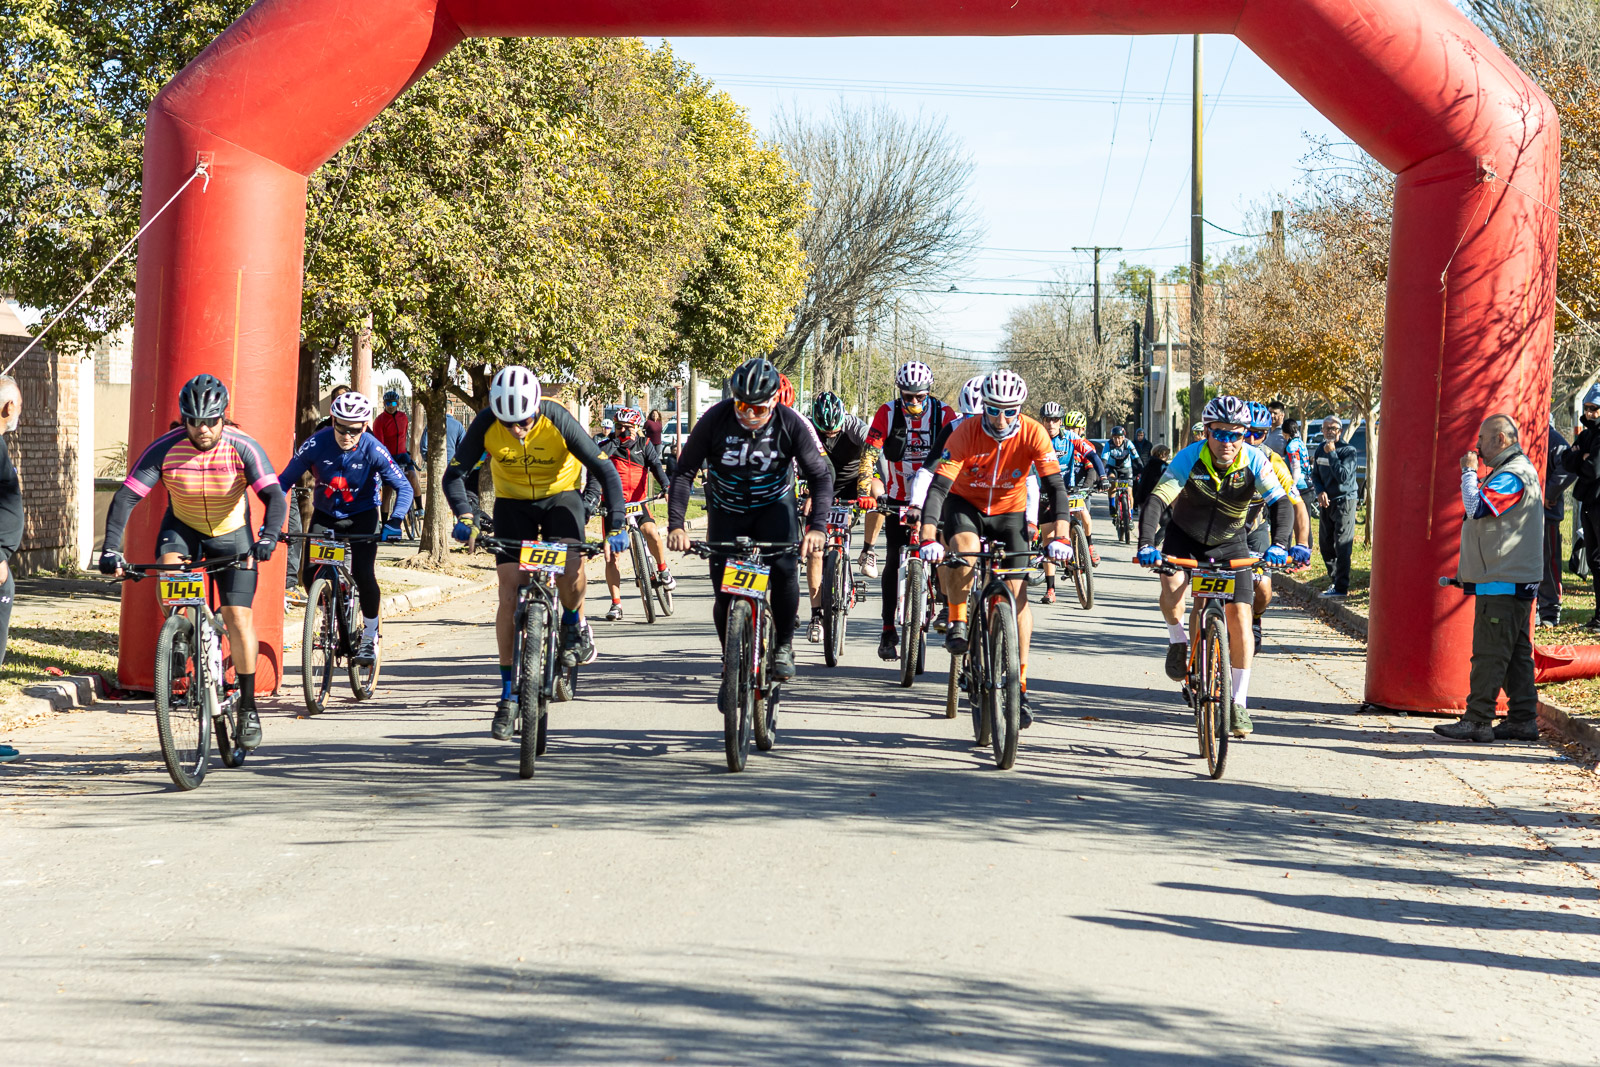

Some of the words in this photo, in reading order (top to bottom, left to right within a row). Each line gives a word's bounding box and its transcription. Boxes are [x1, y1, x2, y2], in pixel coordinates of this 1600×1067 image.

[721, 443, 778, 471] sky
[318, 546, 336, 559] 16
[528, 550, 559, 564] 68
[732, 570, 757, 588] 91
[1199, 578, 1229, 592] 58
[166, 582, 201, 598] 144
